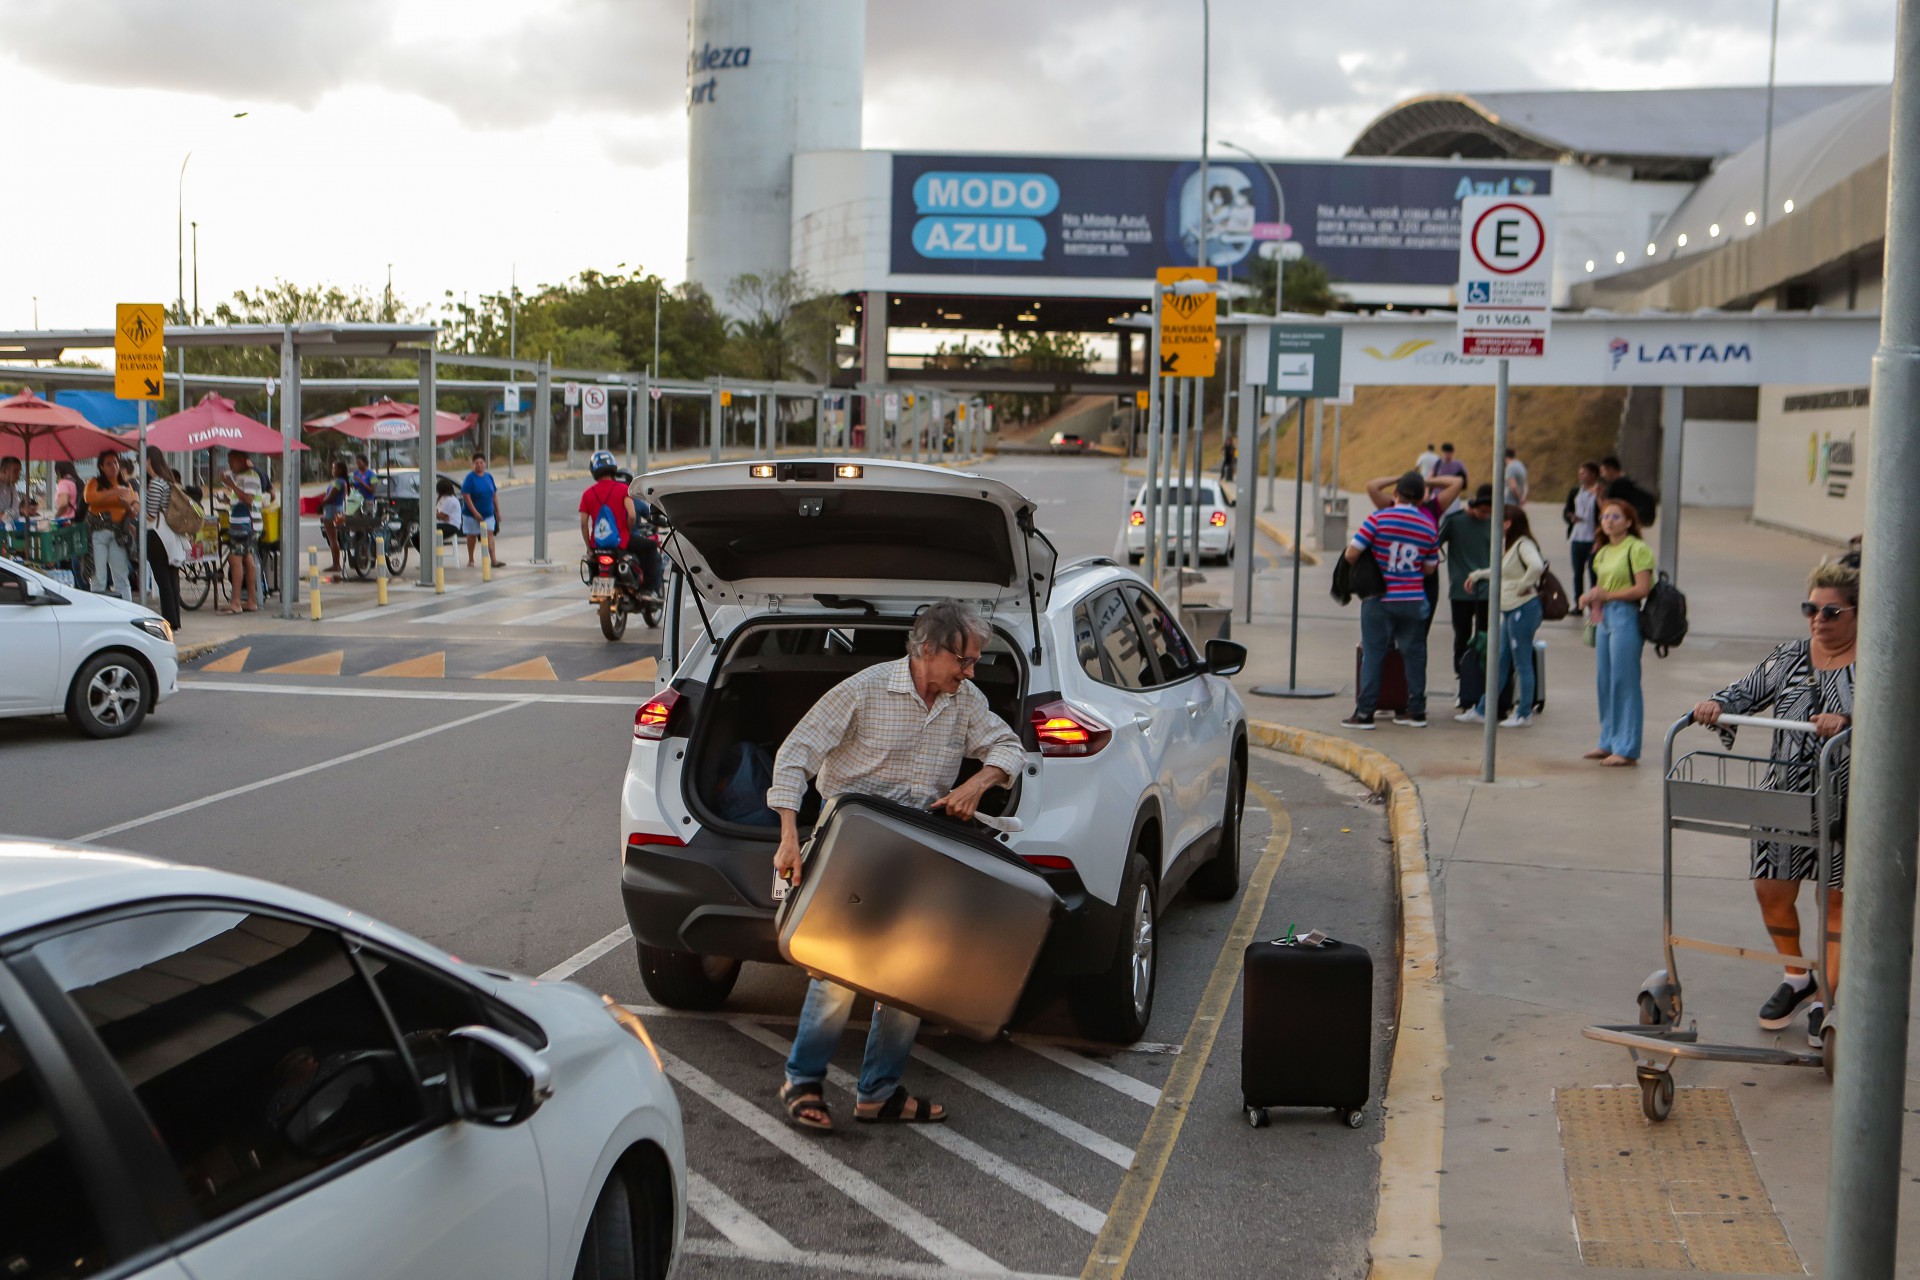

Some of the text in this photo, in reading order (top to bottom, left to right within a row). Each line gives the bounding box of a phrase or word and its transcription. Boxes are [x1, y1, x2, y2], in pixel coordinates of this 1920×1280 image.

[928, 179, 1047, 209] MODO
[1454, 176, 1510, 199] Azul
[925, 223, 1027, 253] AZUL
[1495, 219, 1520, 258] E
[1477, 314, 1532, 325] 01 VAGA
[1162, 325, 1213, 334] RAVESSIA
[1162, 335, 1208, 344] ELEVADA
[117, 353, 162, 361] TRAVESSIA
[1638, 343, 1752, 363] LATAM
[120, 362, 158, 370] ELEVADA
[188, 426, 243, 444] ITAIPAVA
[1387, 541, 1421, 572] 18
